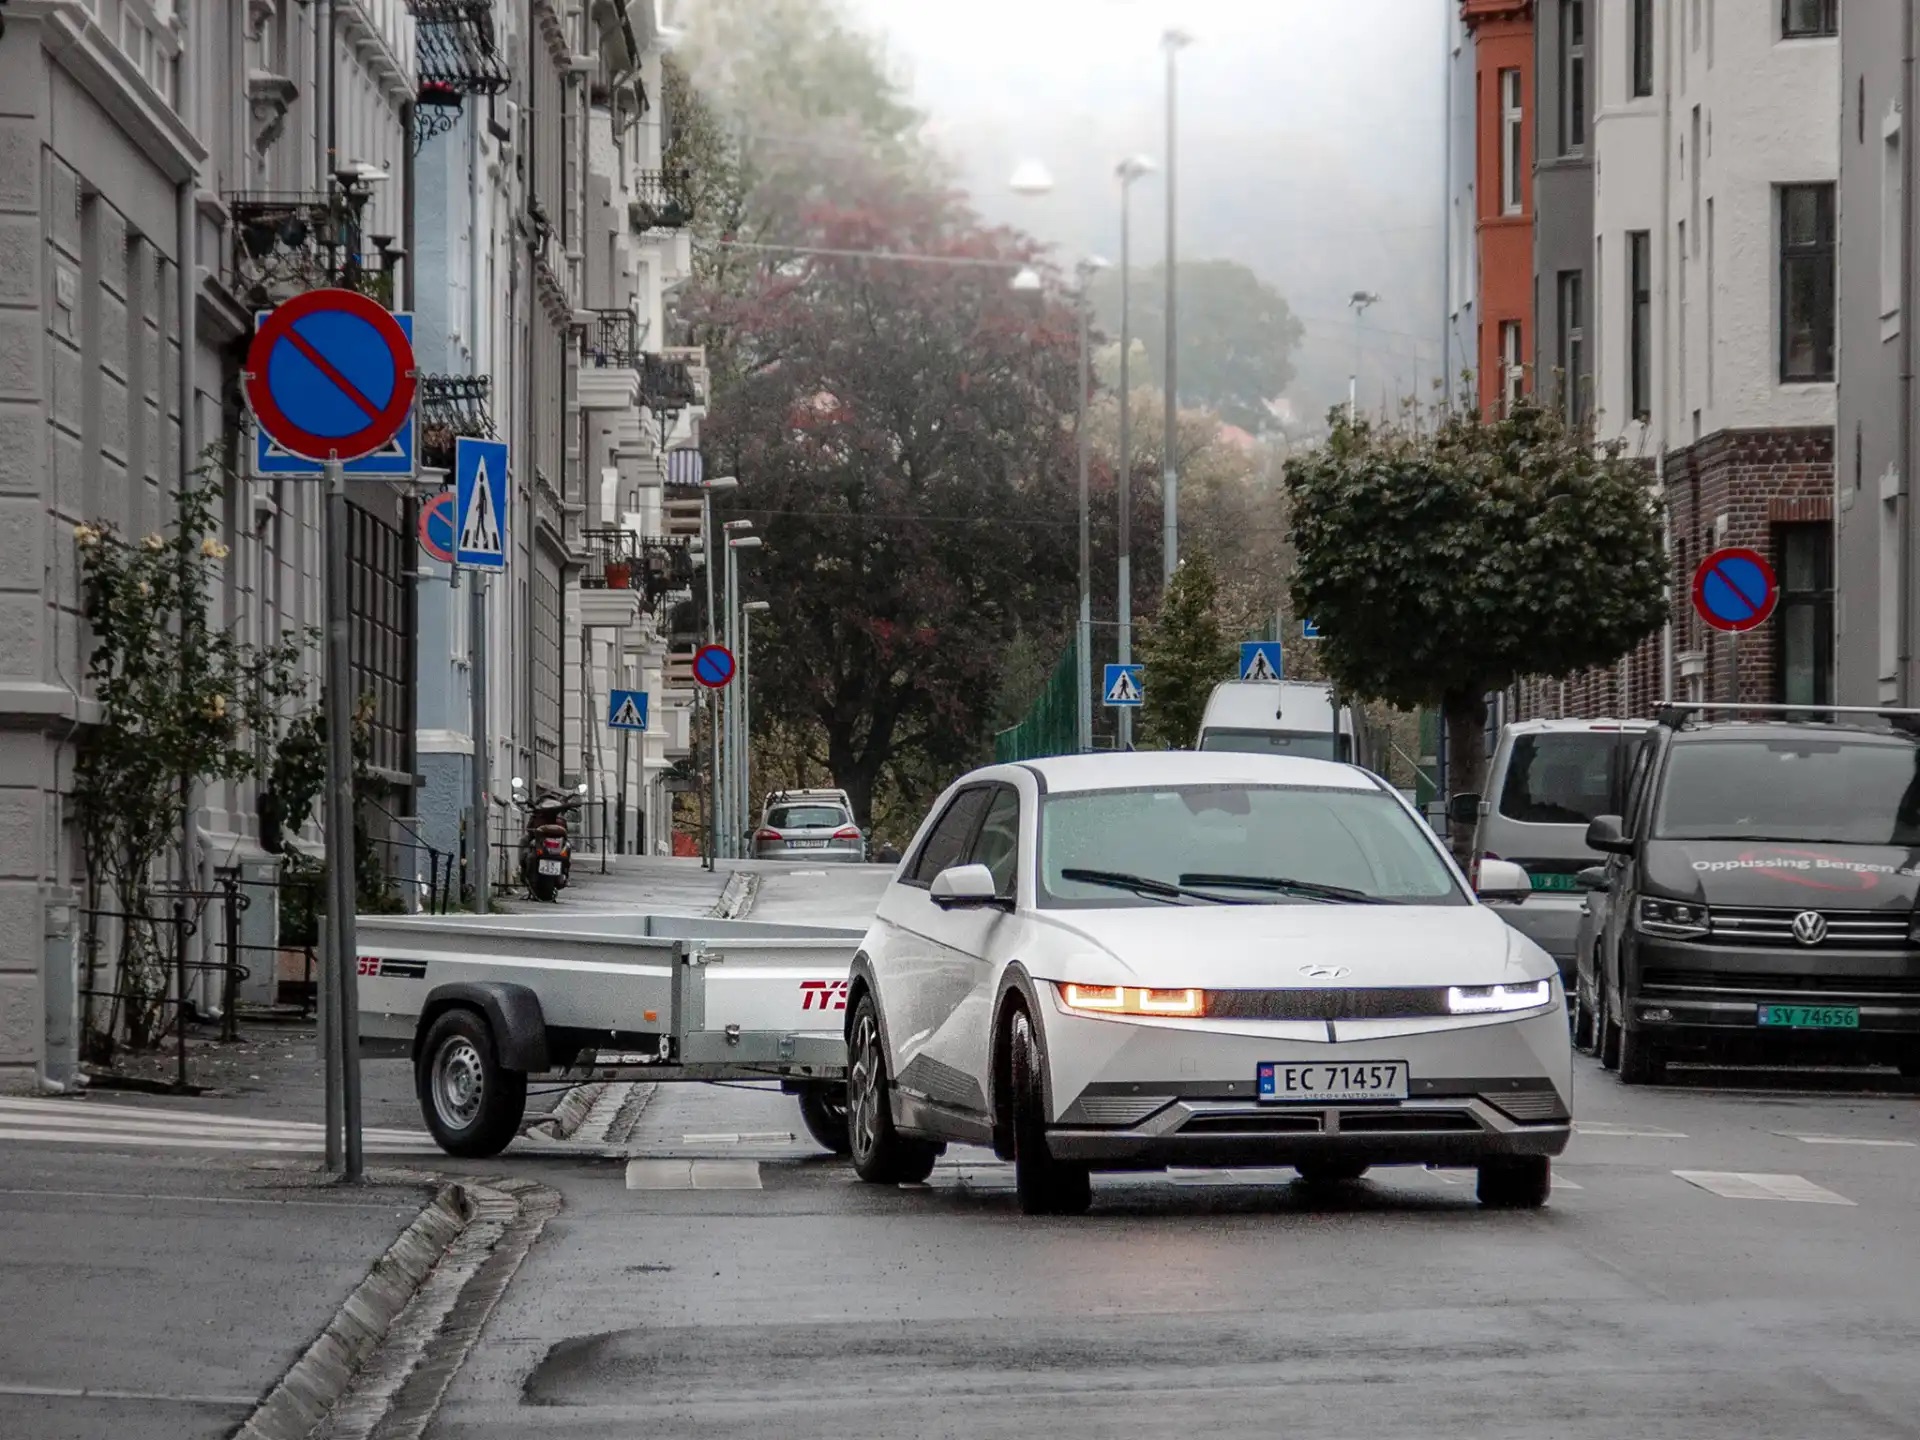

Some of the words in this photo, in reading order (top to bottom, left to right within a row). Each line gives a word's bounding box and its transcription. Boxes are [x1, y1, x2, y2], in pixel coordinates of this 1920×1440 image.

[1692, 857, 1811, 872] Oppussing
[1815, 859, 1895, 873] Bergen
[1773, 1007, 1795, 1024] SV
[1801, 1009, 1855, 1026] 74656
[1285, 1068, 1314, 1091] EC
[1325, 1066, 1398, 1091] 71457
